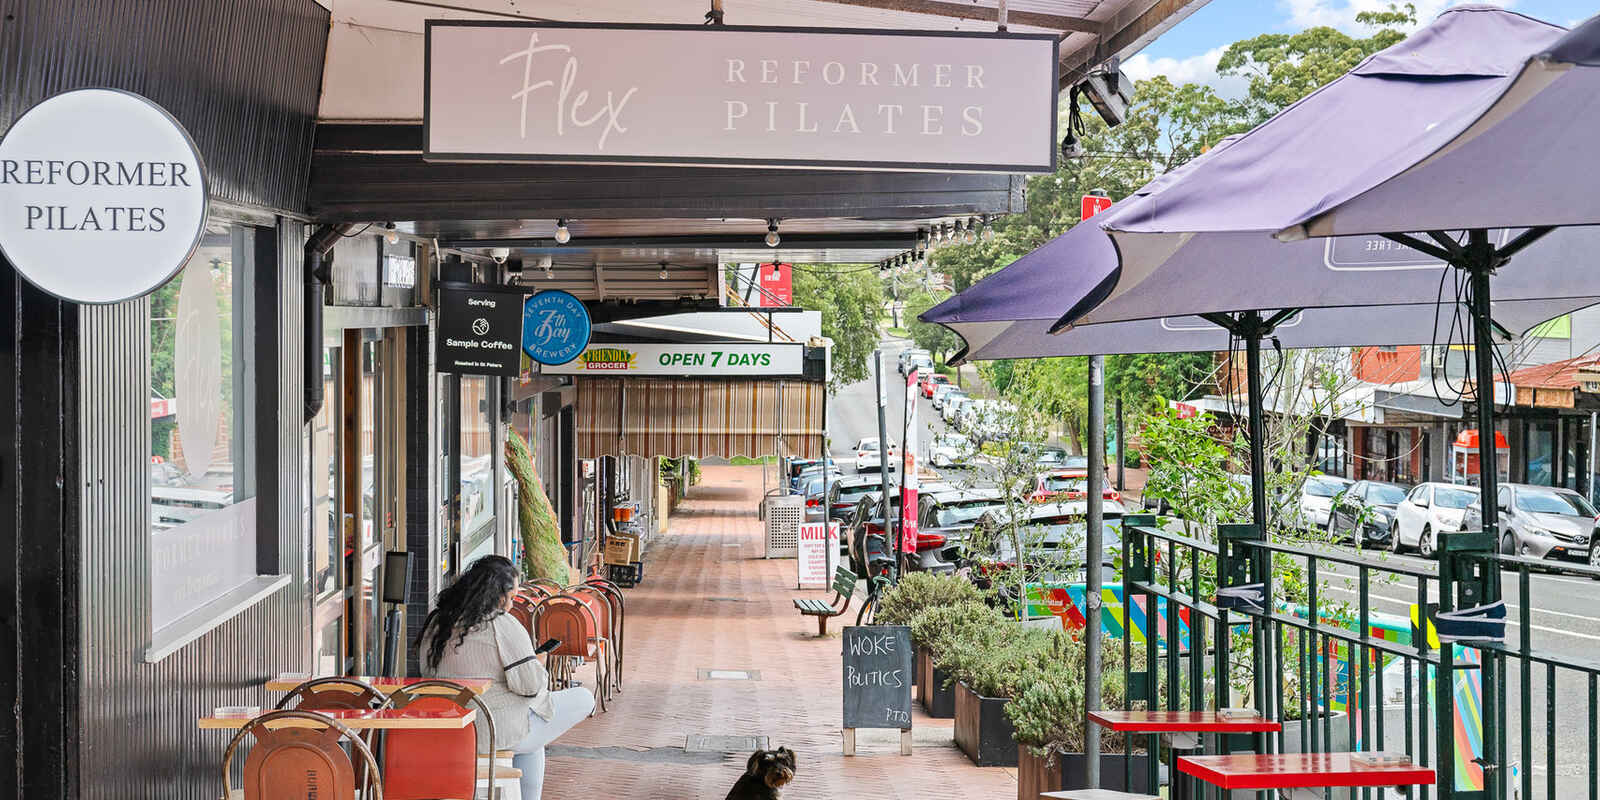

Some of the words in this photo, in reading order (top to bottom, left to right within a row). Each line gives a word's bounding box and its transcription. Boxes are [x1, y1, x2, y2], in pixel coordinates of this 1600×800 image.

[725, 59, 985, 89] REFORMER
[499, 31, 638, 150] Flex
[723, 100, 984, 137] PILATES
[0, 160, 191, 187] REFORMER
[24, 205, 166, 232] PILATES
[468, 298, 496, 308] Serving
[525, 297, 564, 318] SEVENTH
[567, 302, 582, 317] DAY
[446, 339, 479, 349] Sample
[481, 341, 513, 350] Coffee
[529, 343, 576, 359] BREWERY
[587, 348, 629, 362] FRIENDLY
[659, 353, 704, 366] OPEN
[711, 352, 723, 367] 7
[727, 353, 771, 366] DAYS
[800, 526, 838, 540] MILK
[849, 634, 896, 656] WOKE
[847, 665, 903, 688] POLITICS
